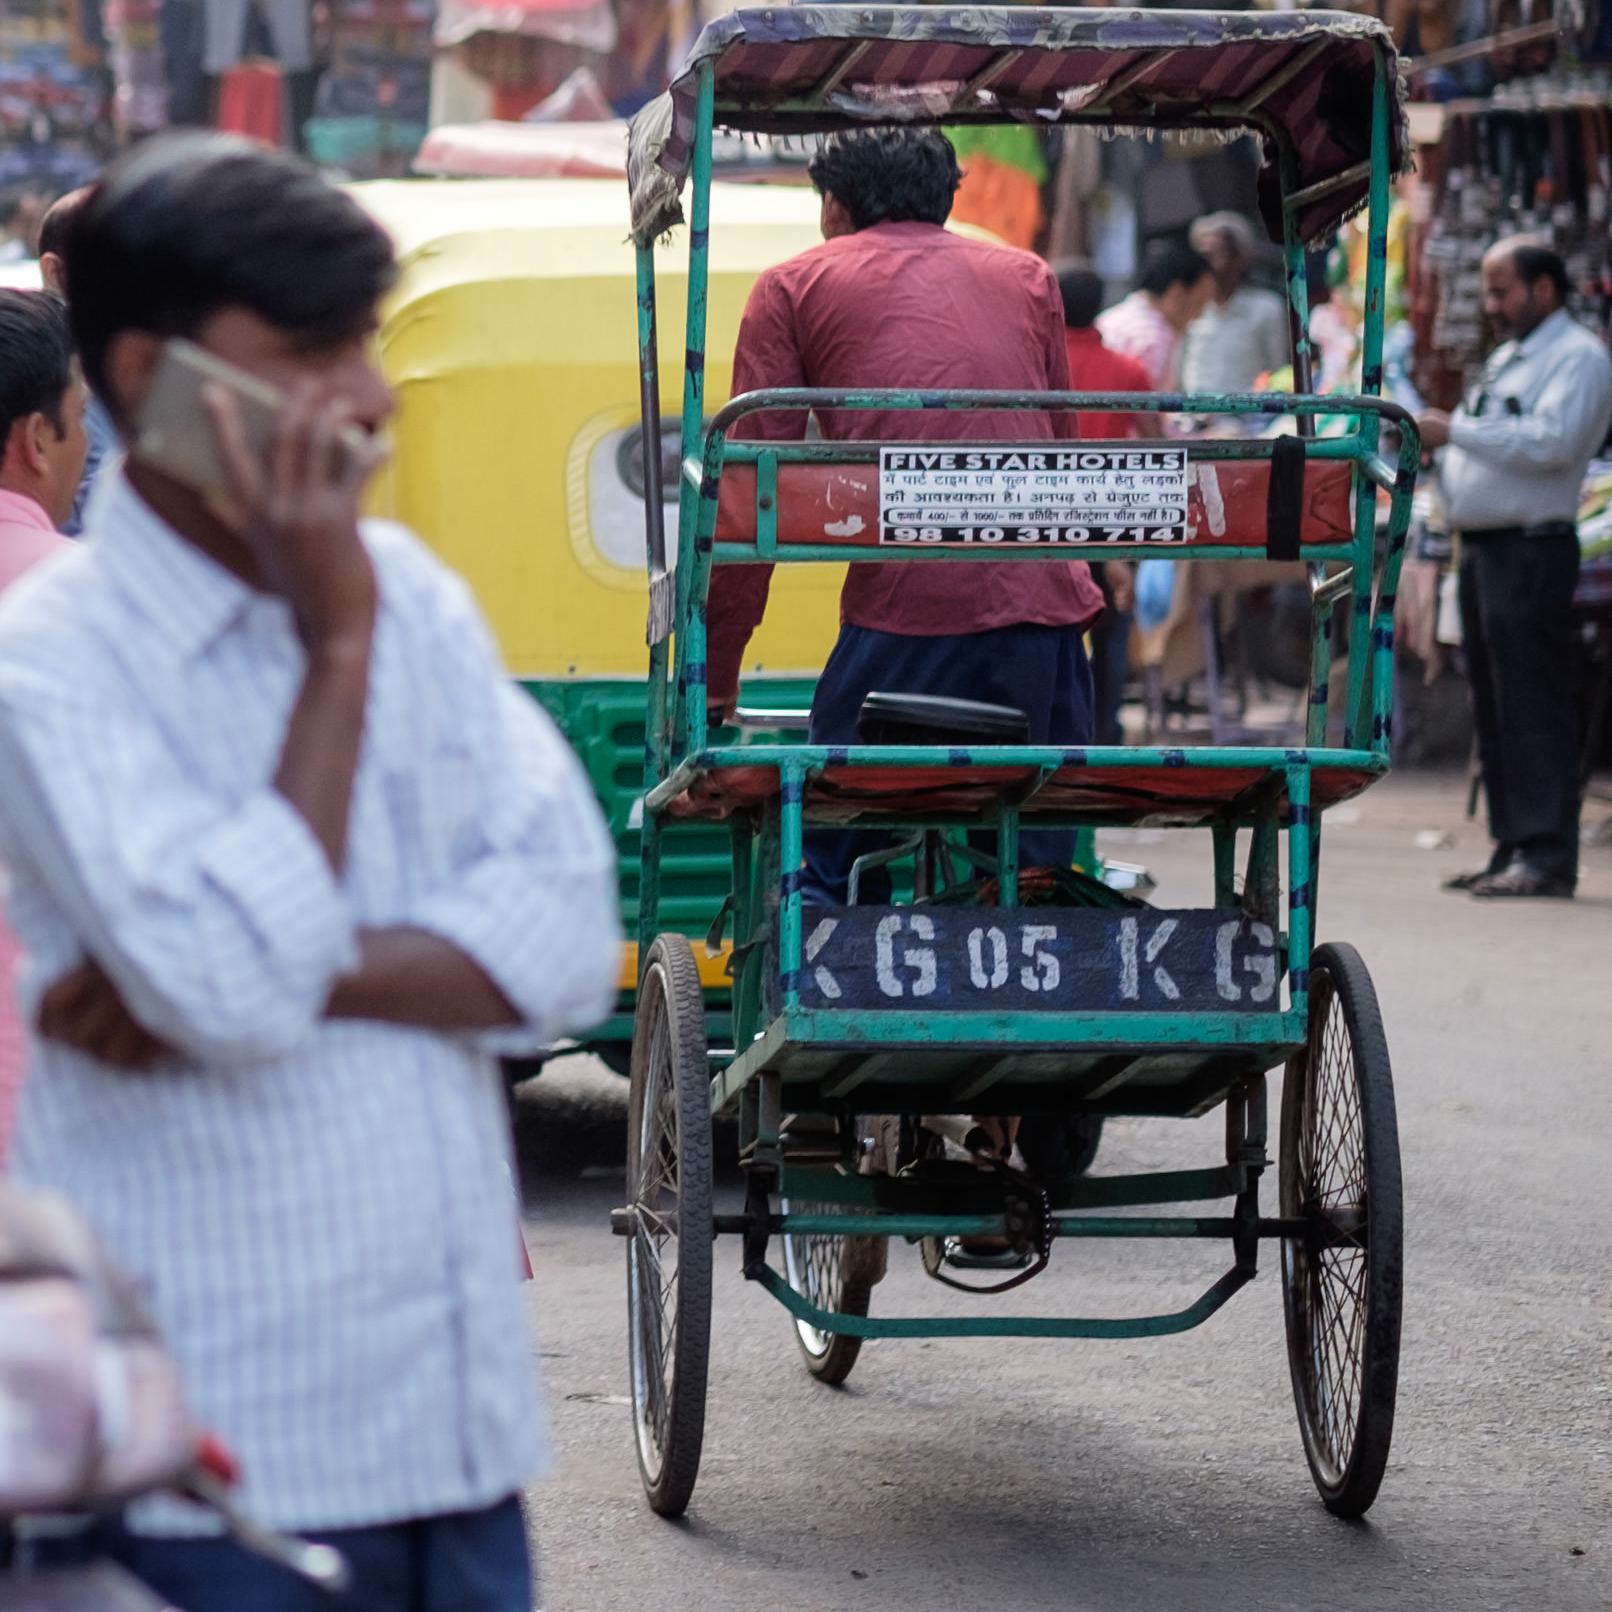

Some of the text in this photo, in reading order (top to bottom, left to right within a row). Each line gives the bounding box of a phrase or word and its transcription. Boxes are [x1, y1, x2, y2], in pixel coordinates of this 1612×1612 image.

[890, 453, 1180, 470] FIVE STAR HOTELS
[883, 471, 896, 485] में
[902, 469, 927, 486] पार्ट
[934, 475, 968, 487] टाइम
[975, 472, 995, 486] एवं
[1035, 474, 1068, 487] टाइम
[1076, 470, 1107, 486] कार्य
[1114, 471, 1136, 490] हेतु
[885, 490, 904, 503] की
[913, 492, 995, 504] आवश्यकता
[1082, 489, 1097, 503] से
[1159, 492, 1184, 503] तक
[893, 526, 1175, 543] 98 10 310 714
[966, 924, 1062, 992] 05
[1116, 915, 1277, 1003] KG
